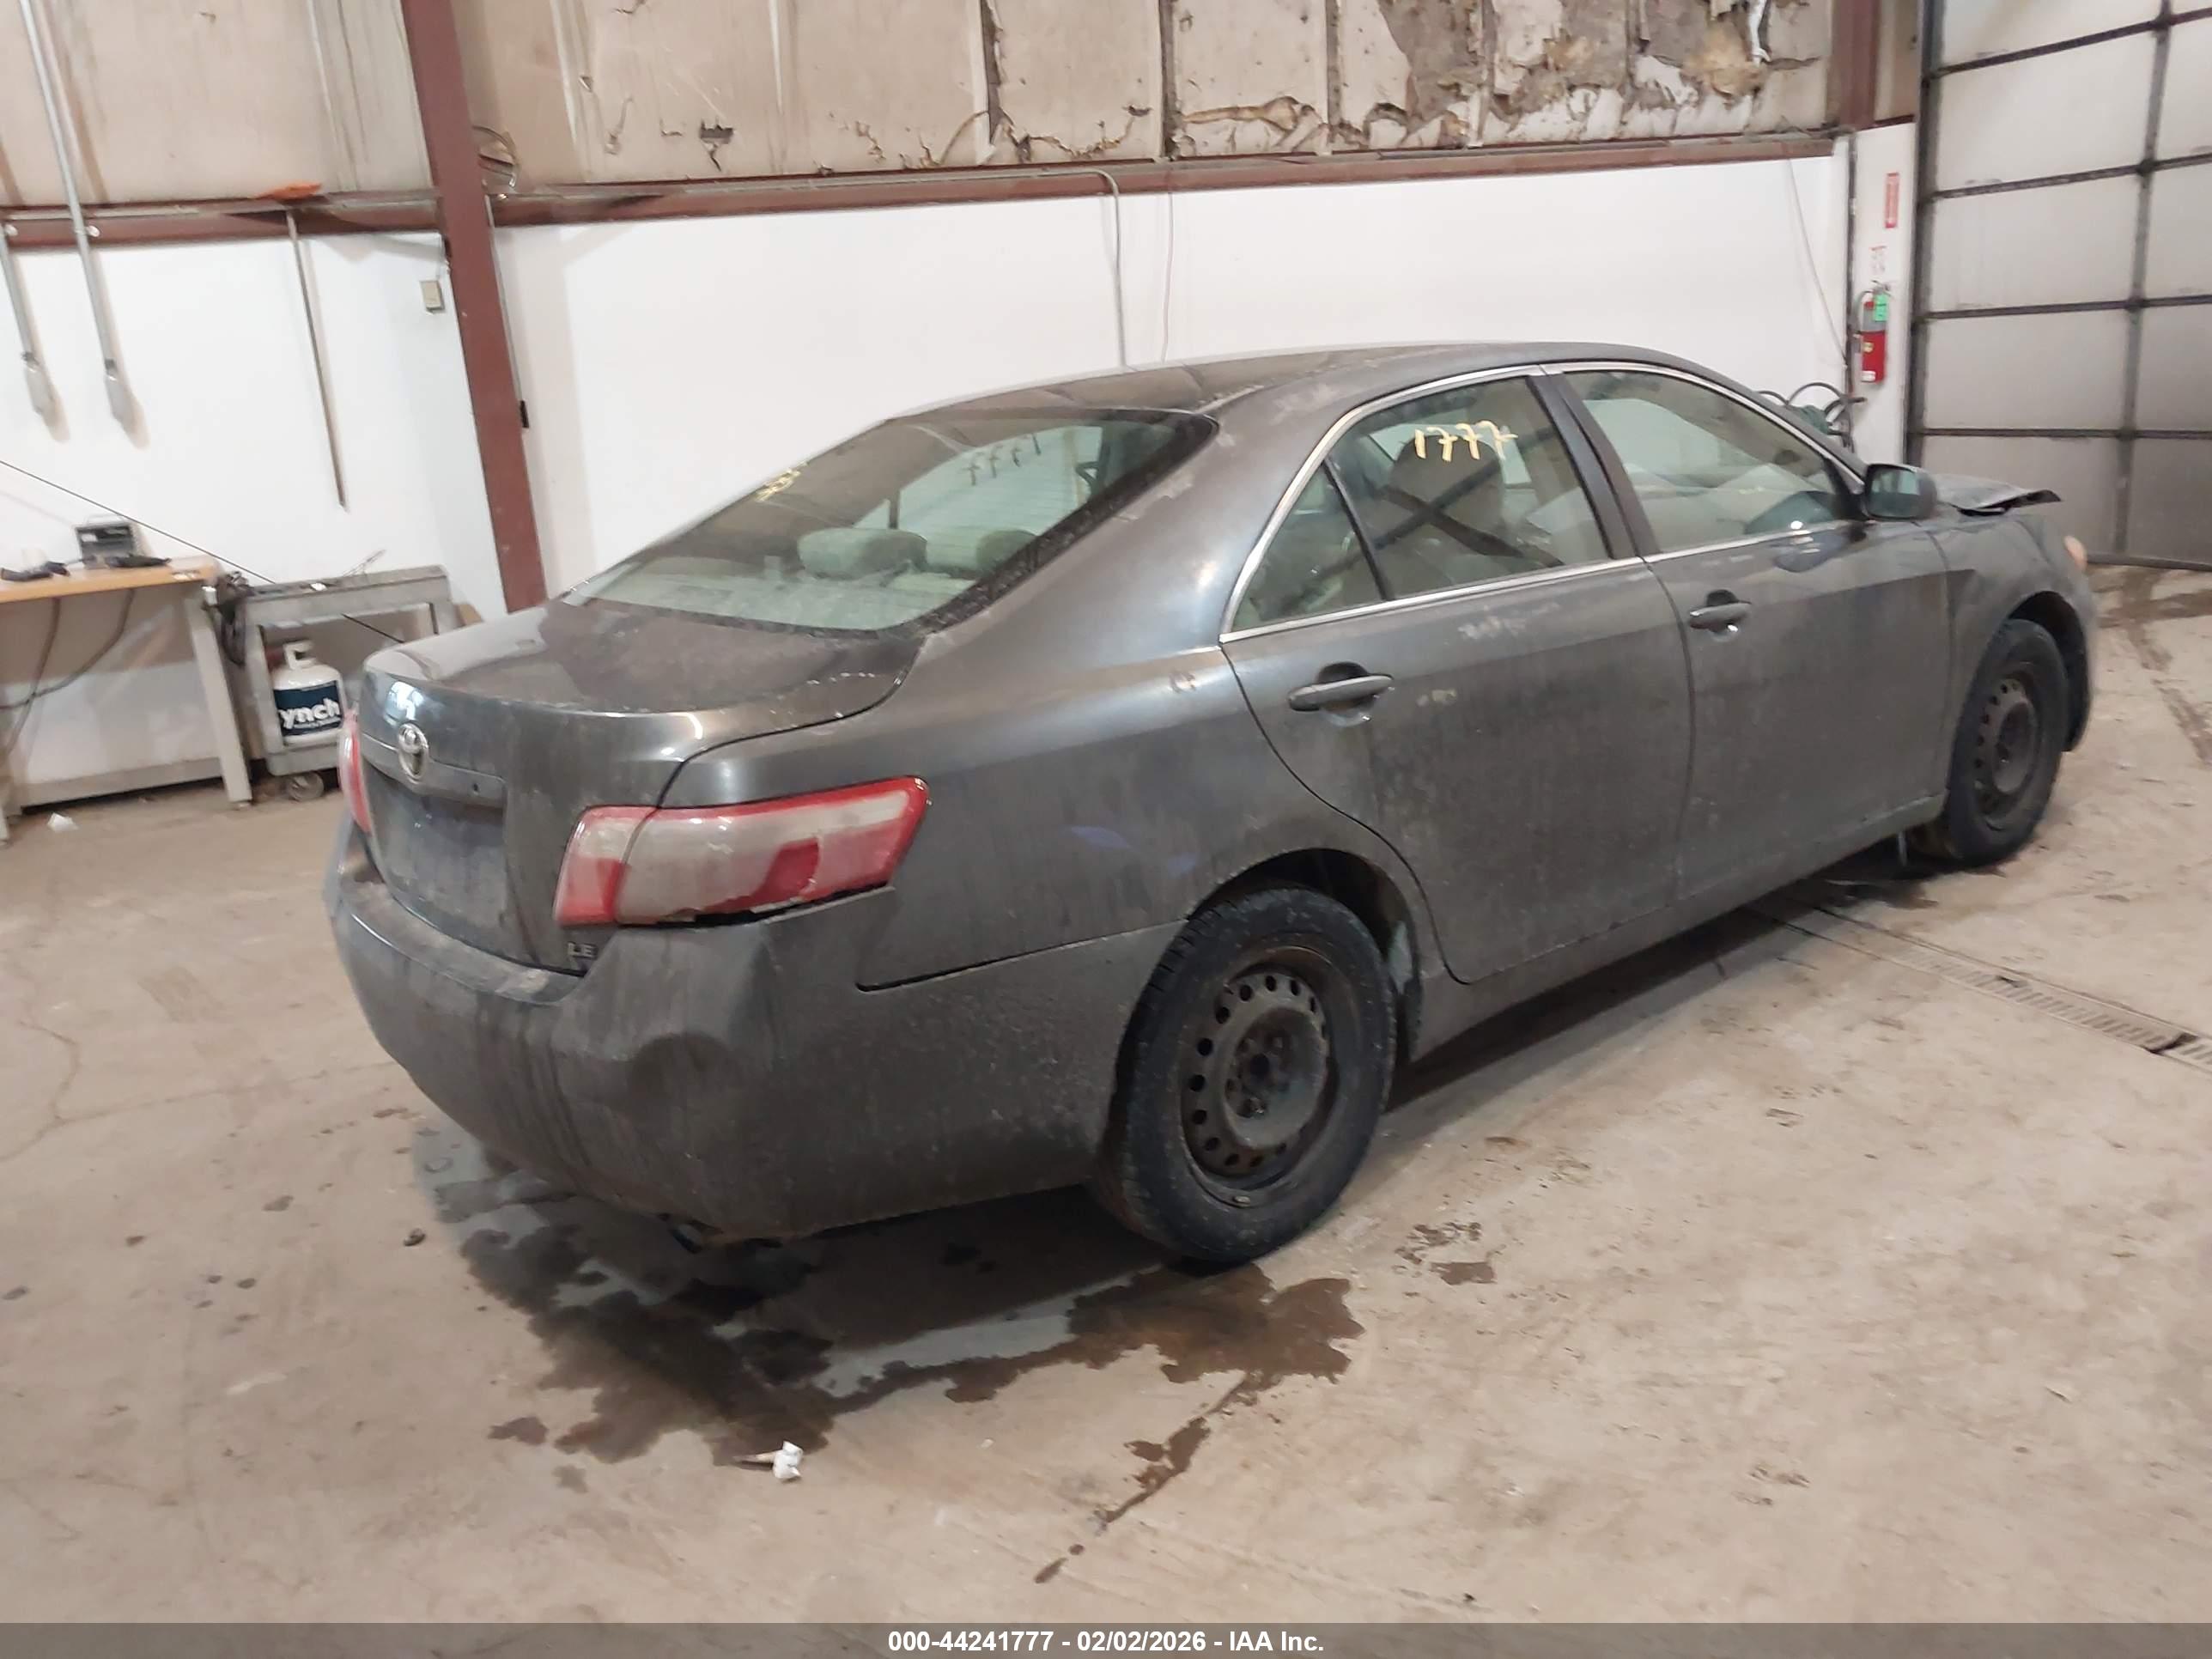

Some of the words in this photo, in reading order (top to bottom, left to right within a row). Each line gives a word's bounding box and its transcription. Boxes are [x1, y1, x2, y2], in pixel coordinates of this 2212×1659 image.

[1415, 420, 1518, 462] 1777
[277, 697, 340, 729] ynch
[567, 941, 599, 959] LE
